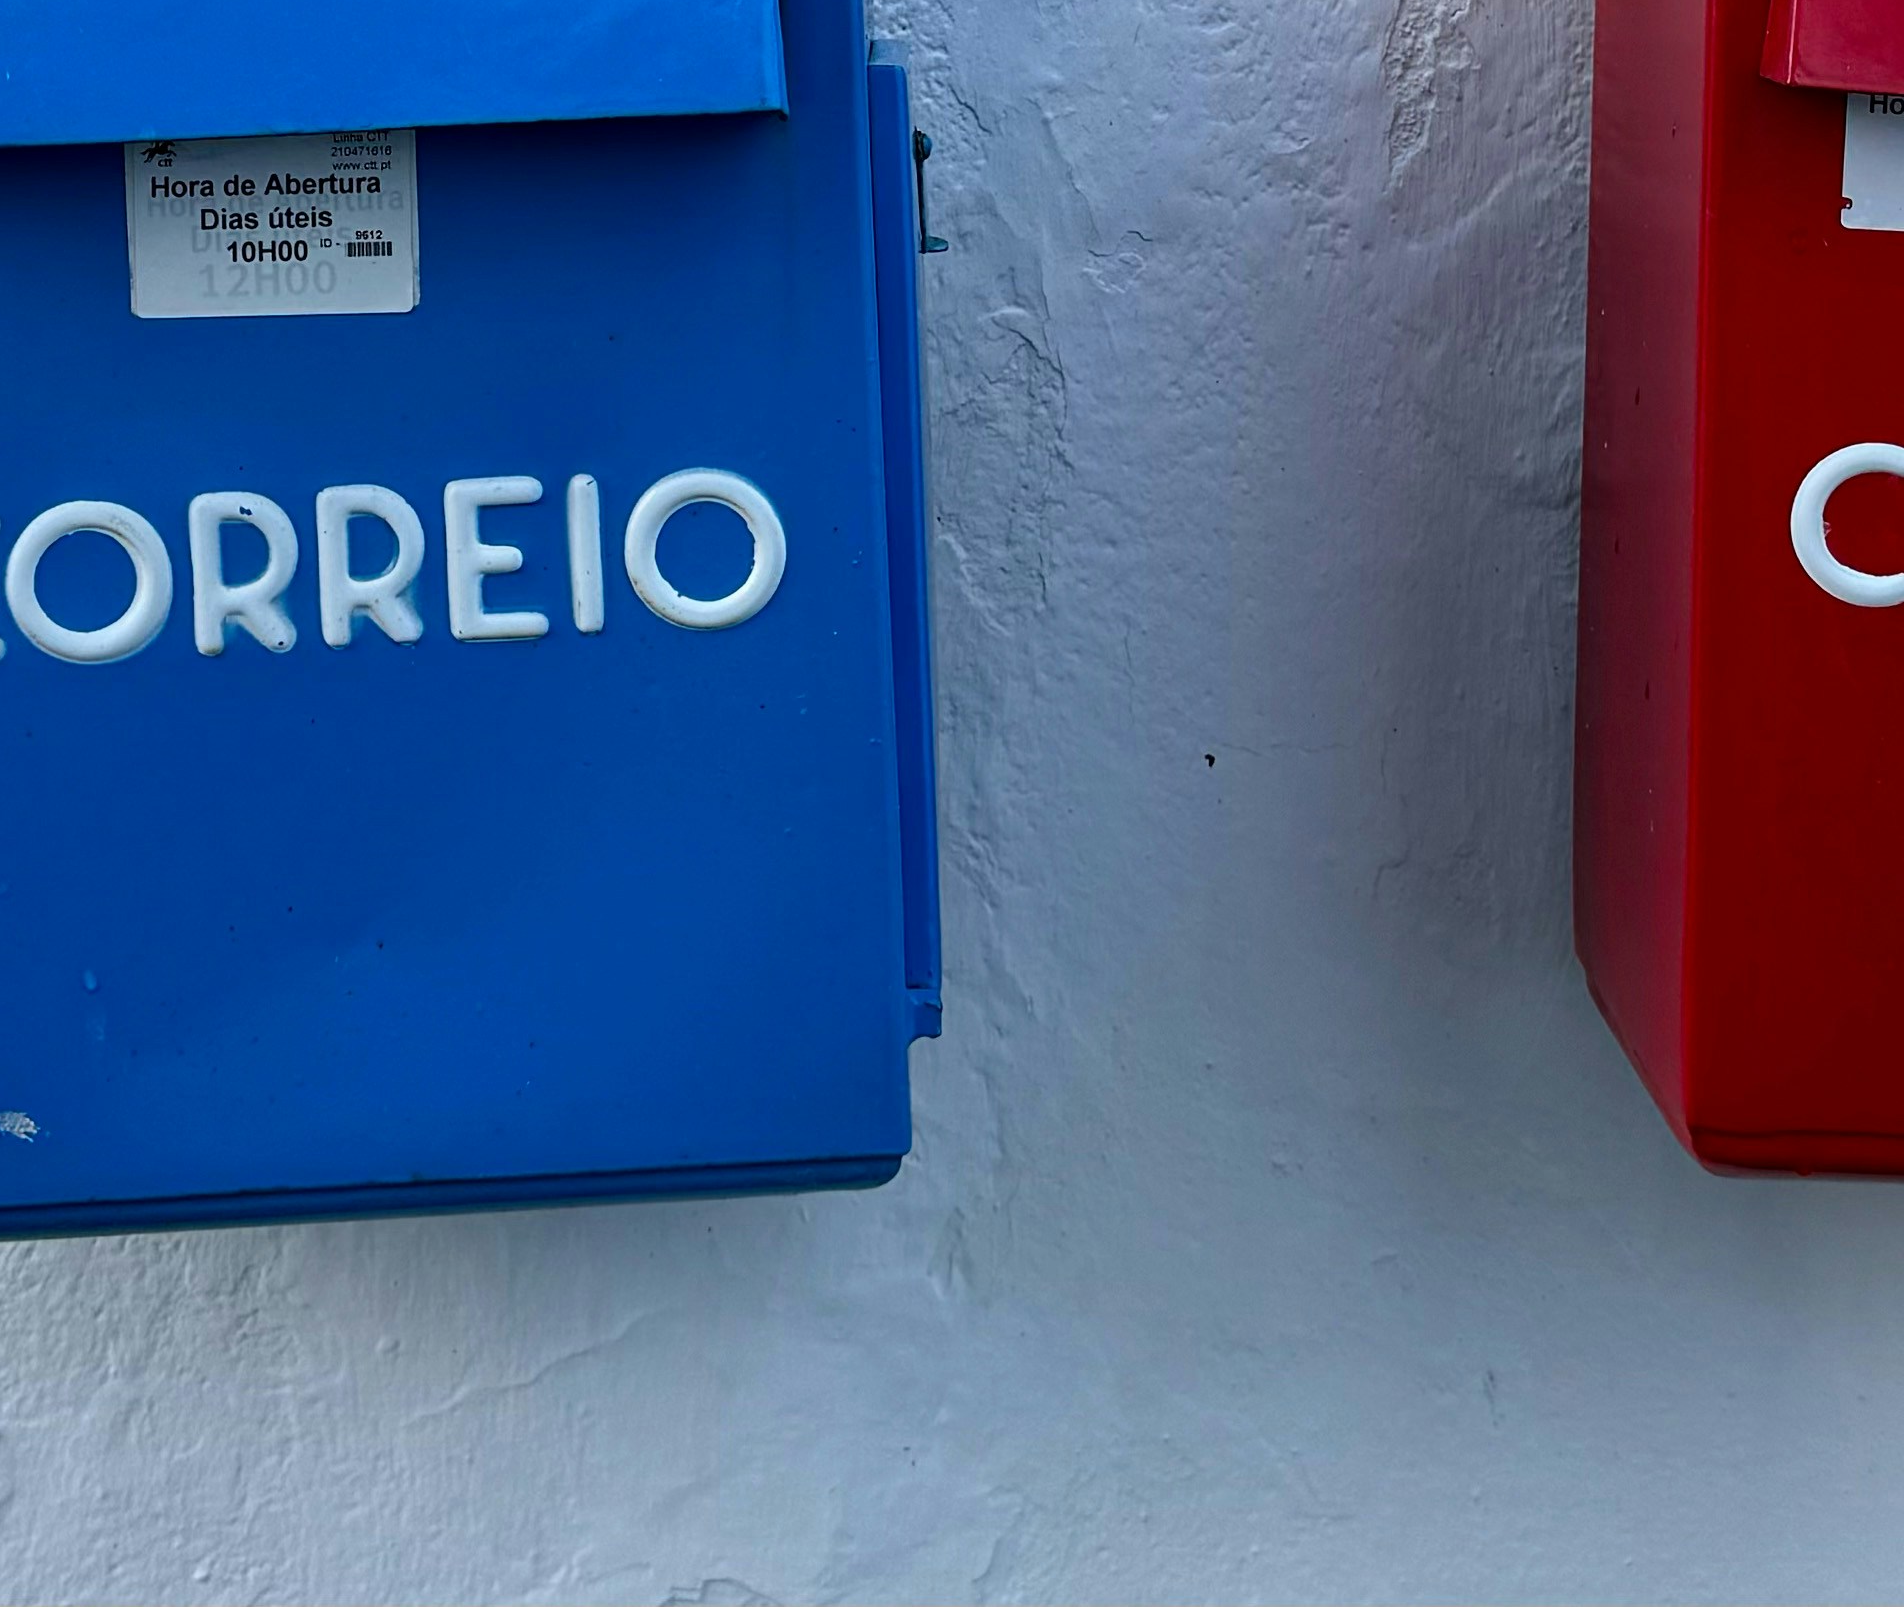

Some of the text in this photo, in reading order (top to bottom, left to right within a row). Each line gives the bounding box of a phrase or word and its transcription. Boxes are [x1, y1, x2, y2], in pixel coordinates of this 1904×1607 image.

[331, 160, 392, 171] www.ctt.pt
[150, 172, 381, 199] Hora de Abertura
[200, 205, 333, 231] Dias úteis
[226, 239, 309, 263] 10H00
[319, 237, 333, 248] ID
